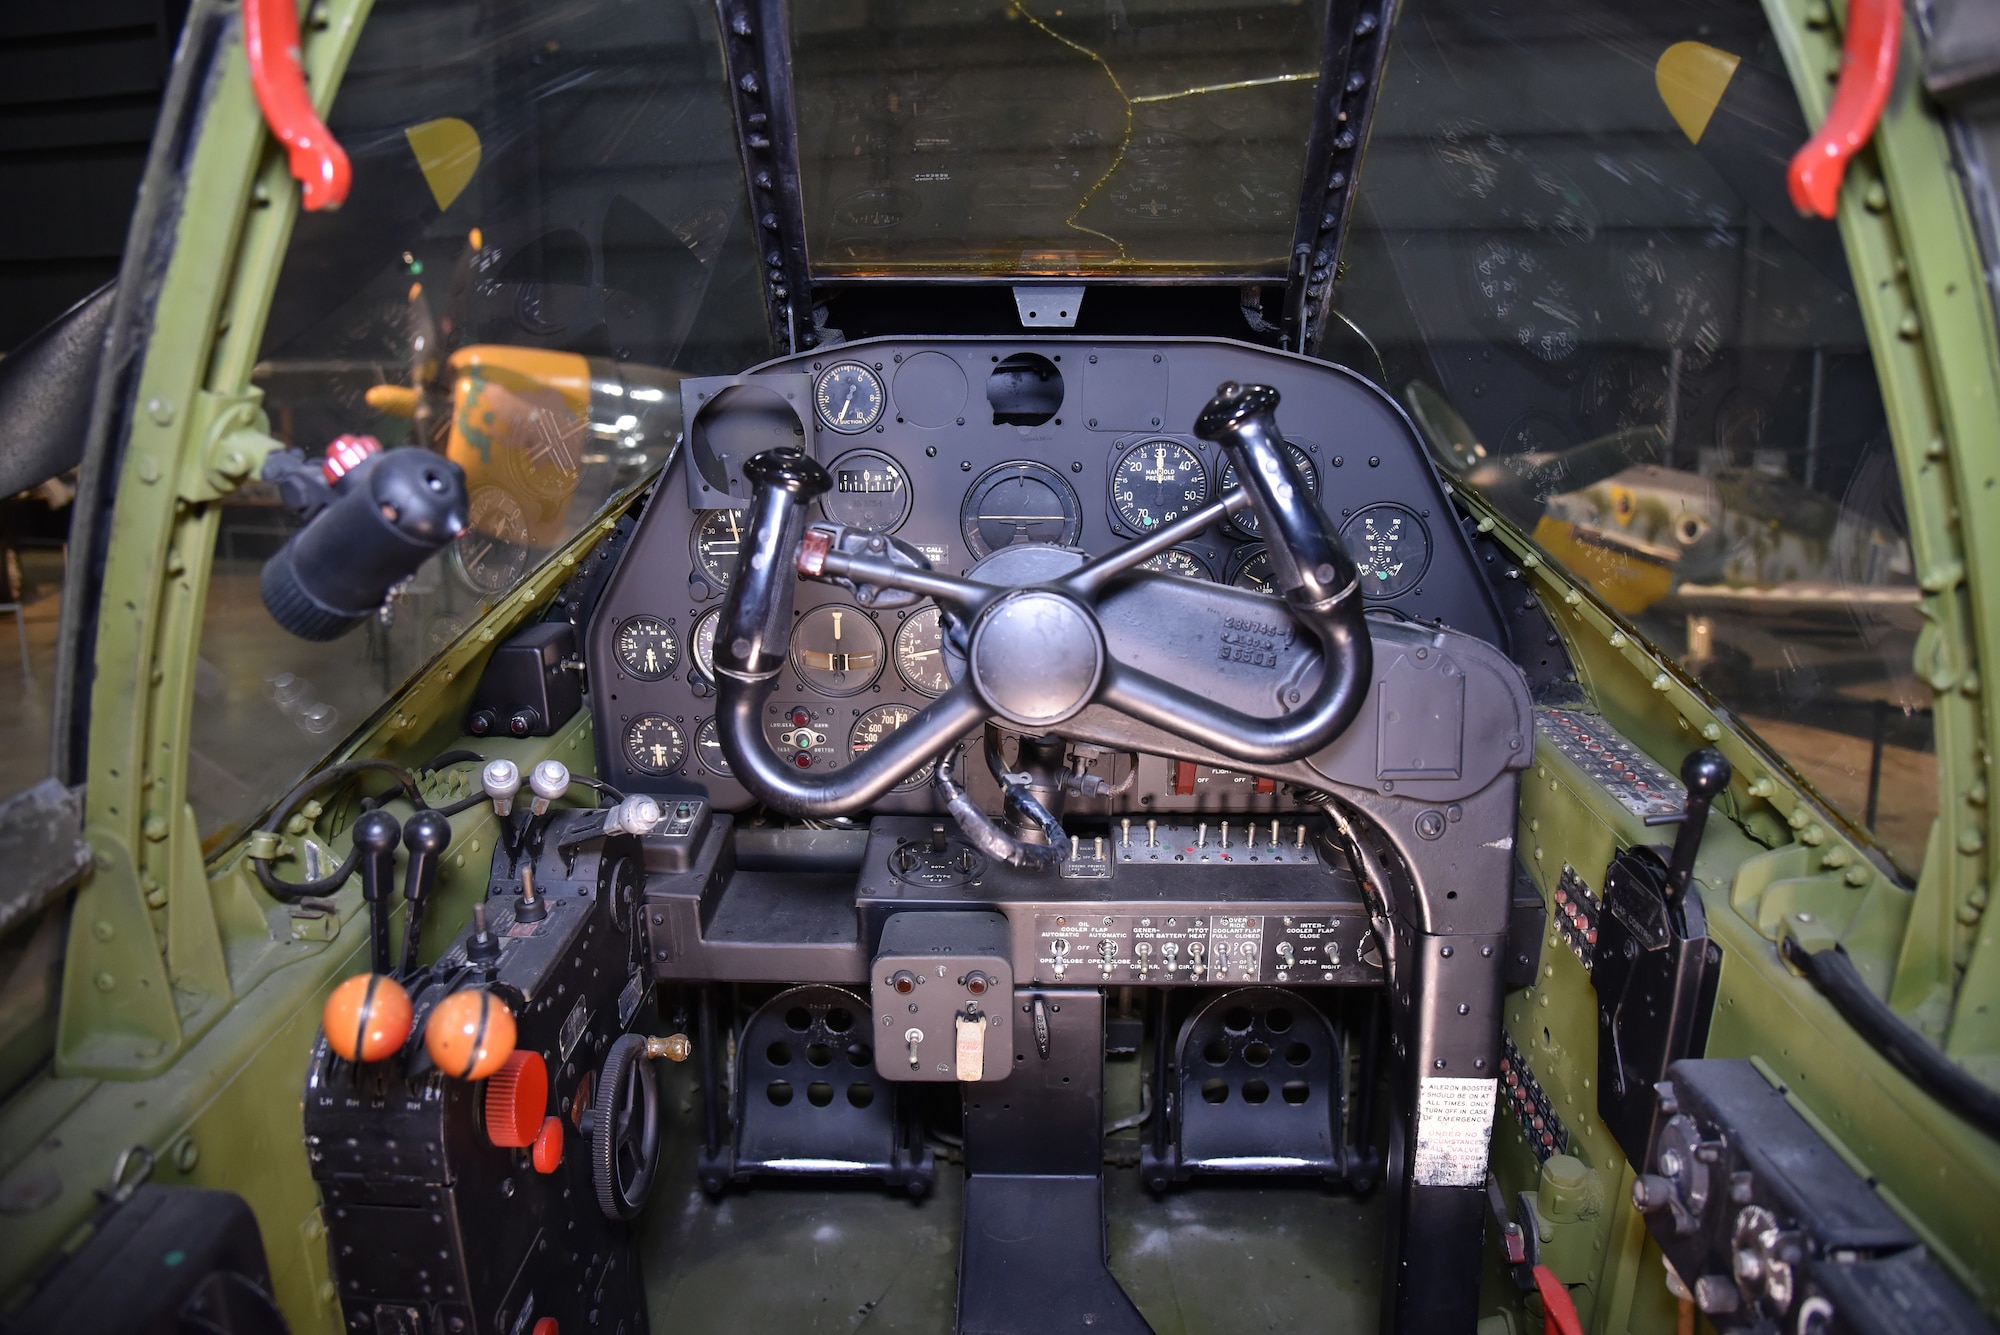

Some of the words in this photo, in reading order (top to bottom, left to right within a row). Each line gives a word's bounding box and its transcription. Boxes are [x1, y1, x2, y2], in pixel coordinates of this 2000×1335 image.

[1154, 449, 1166, 458] 30
[1130, 462, 1142, 472] 20
[1178, 461, 1191, 471] 40
[863, 471, 870, 481] 0
[1124, 492, 1133, 500] 10
[1184, 490, 1196, 500] 50
[1138, 509, 1148, 517] 70
[1165, 512, 1177, 521] 60
[934, 617, 940, 626] 2
[706, 632, 712, 641] 8
[708, 650, 713, 660] 7
[935, 673, 942, 682] 2
[882, 716, 894, 724] 700
[899, 714, 908, 722] 50
[869, 724, 882, 732] 600
[864, 733, 878, 742] 500
[1628, 914, 1655, 945] CONTROL
[320, 1097, 333, 1106] LH
[346, 1099, 359, 1107] RH
[406, 1102, 421, 1110] RH
